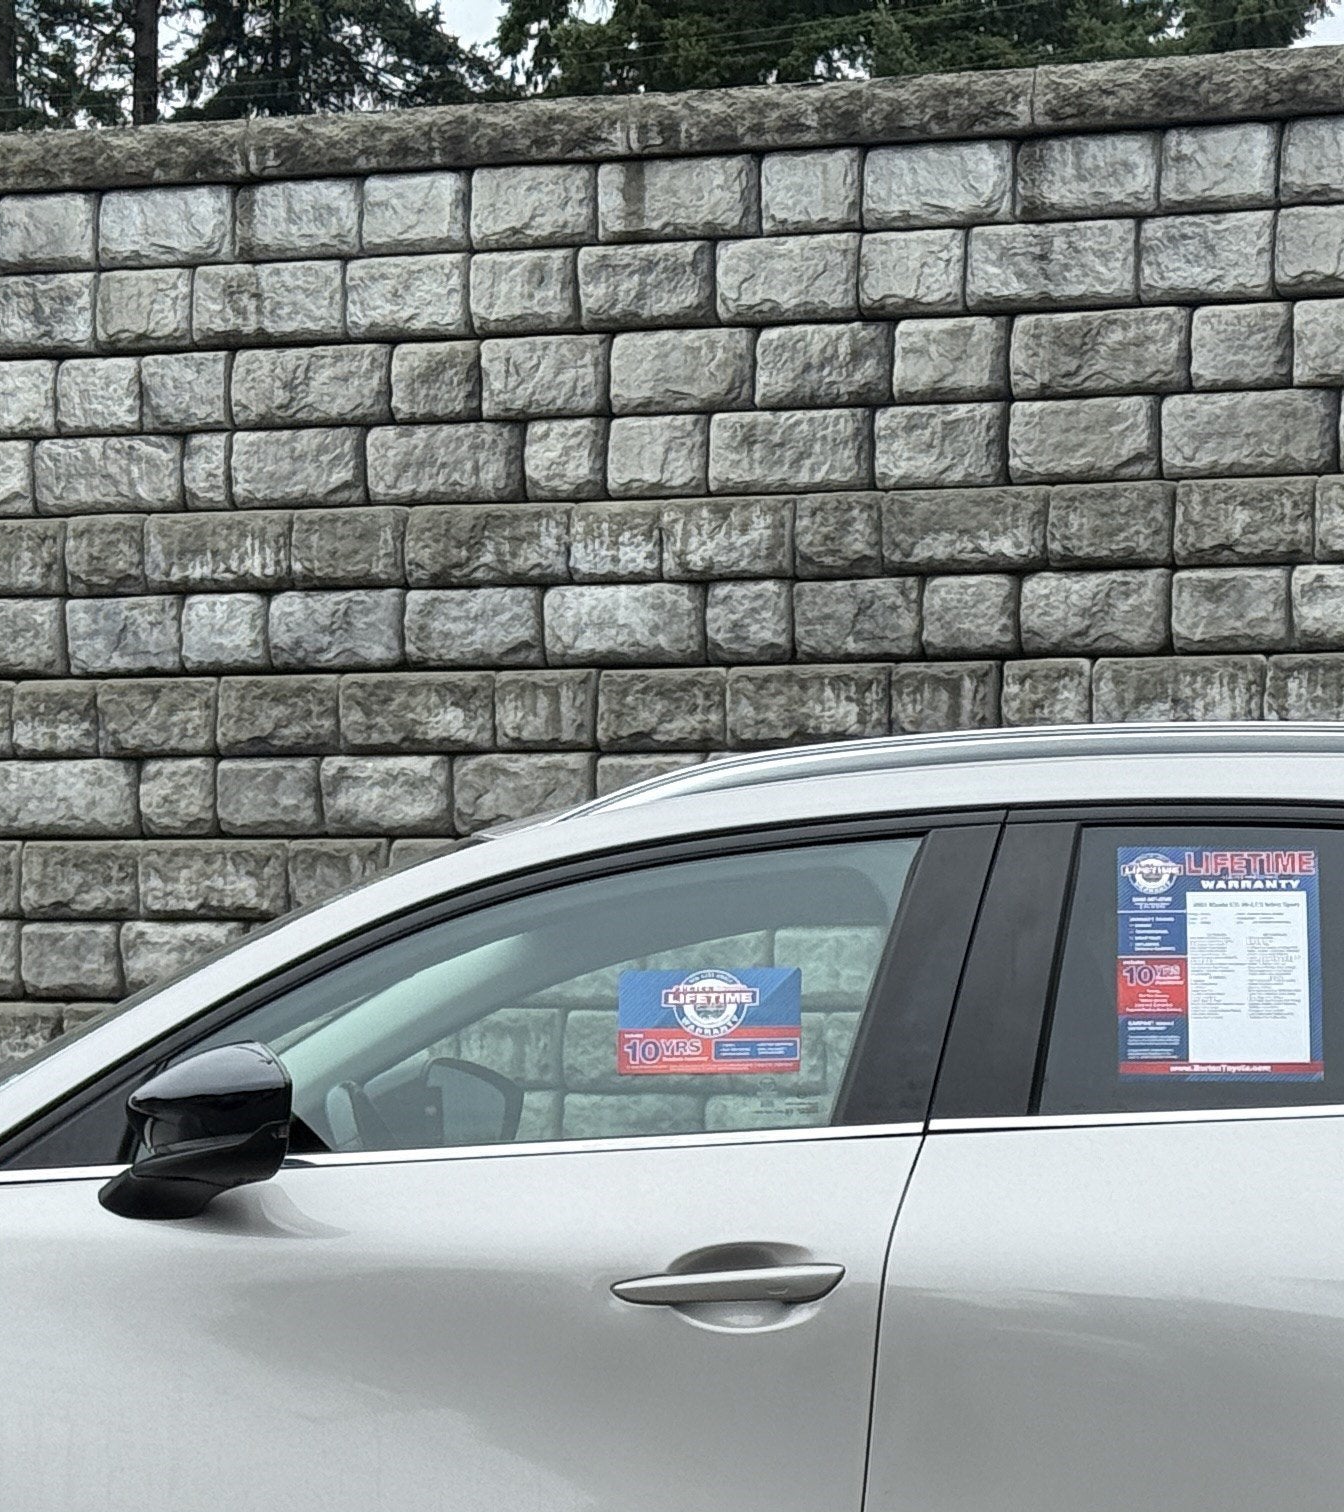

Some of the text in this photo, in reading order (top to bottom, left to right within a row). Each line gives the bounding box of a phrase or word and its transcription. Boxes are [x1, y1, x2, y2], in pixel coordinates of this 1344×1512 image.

[1186, 850, 1315, 876] LIFETIME
[1200, 880, 1302, 890] WARRANTY
[1123, 965, 1156, 986] 10
[667, 992, 753, 1005] LIFETIME
[681, 1014, 740, 1036] WARRANTY
[624, 1038, 662, 1064] 10
[661, 1039, 703, 1056] YRS
